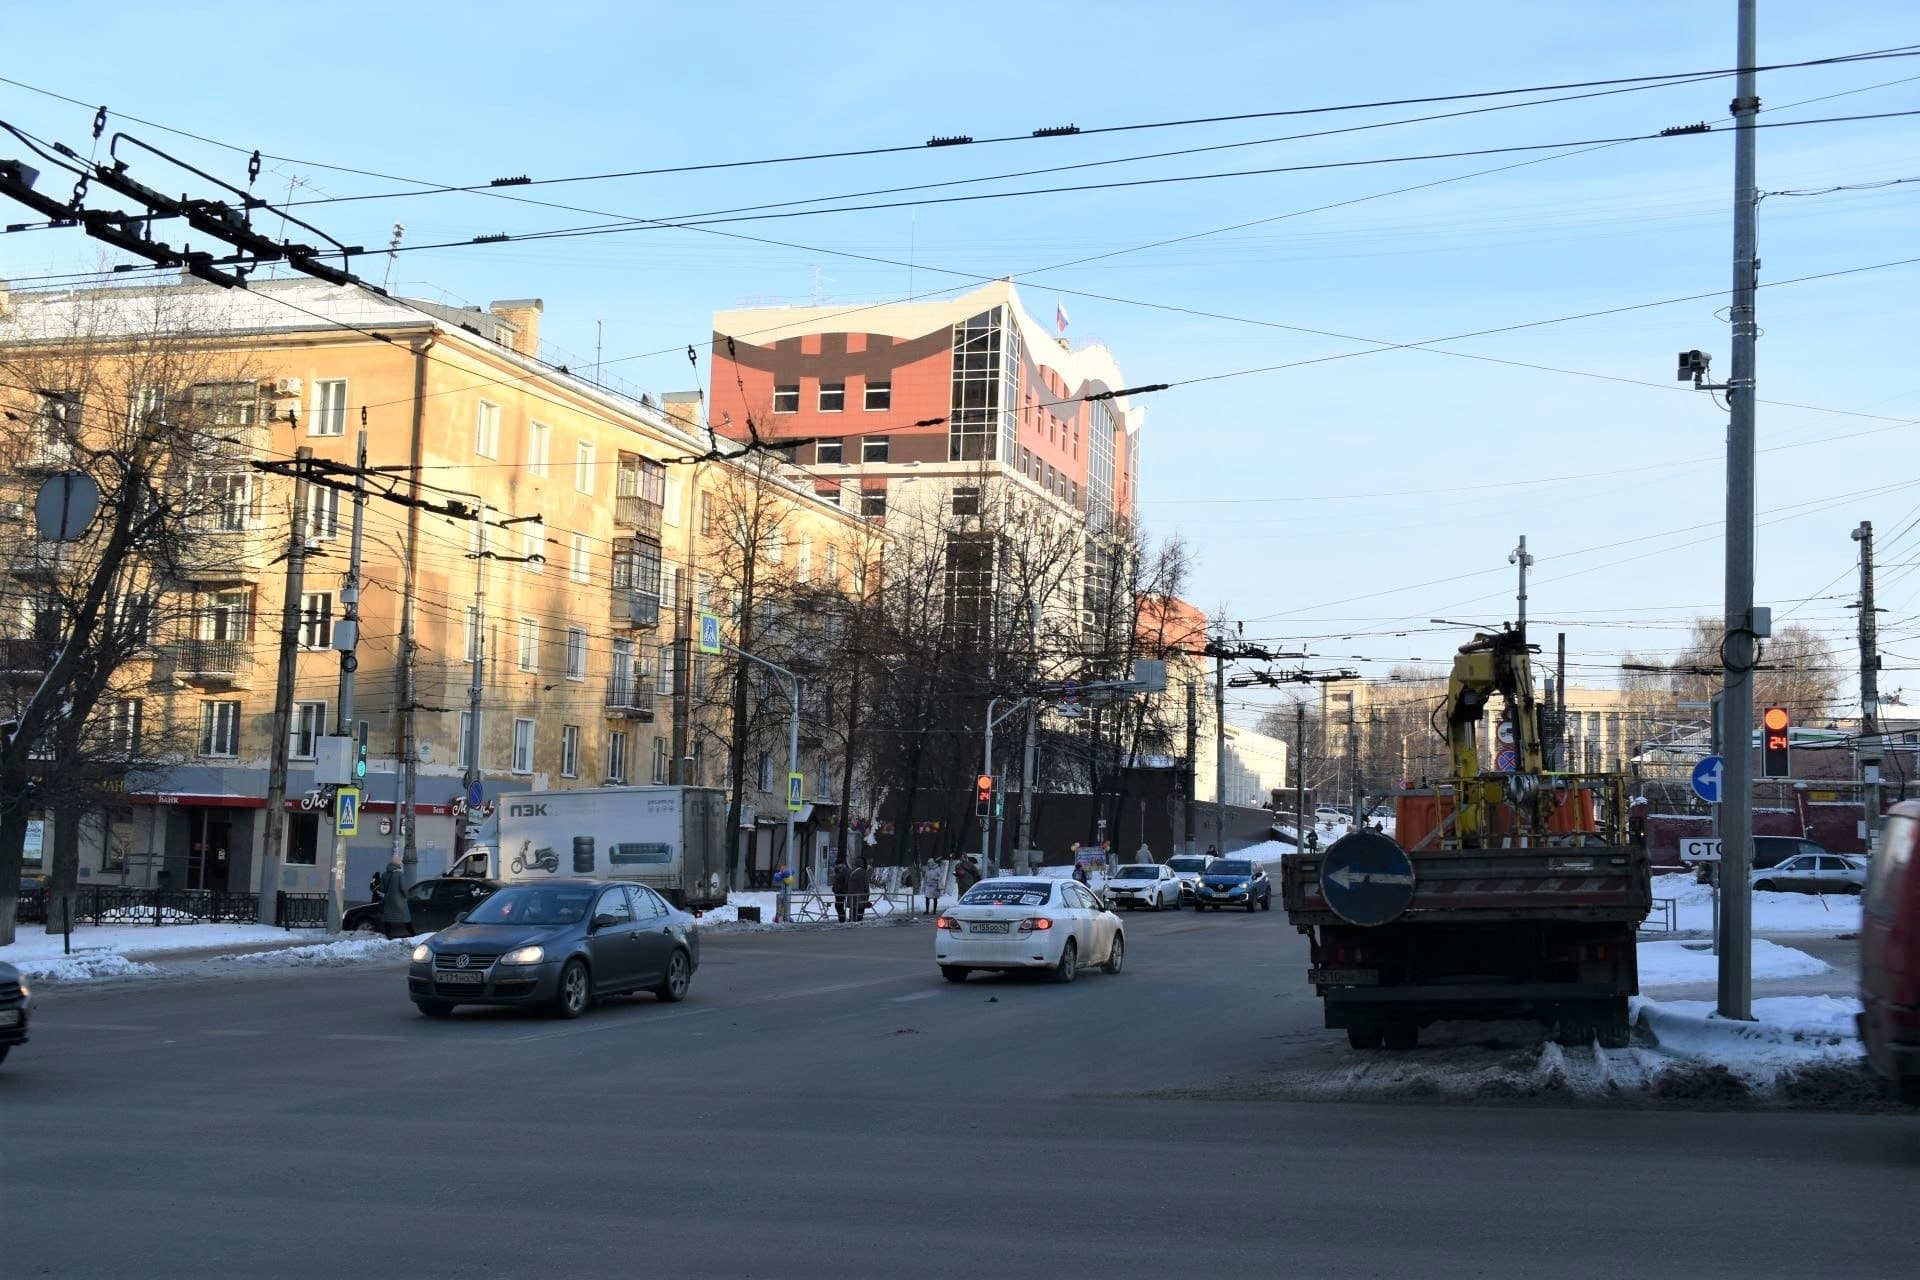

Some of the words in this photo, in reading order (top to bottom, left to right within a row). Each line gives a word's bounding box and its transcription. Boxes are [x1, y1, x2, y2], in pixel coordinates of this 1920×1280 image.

[1770, 736, 1787, 749] 24
[979, 792, 989, 800] 24
[510, 803, 547, 817] ПЭК
